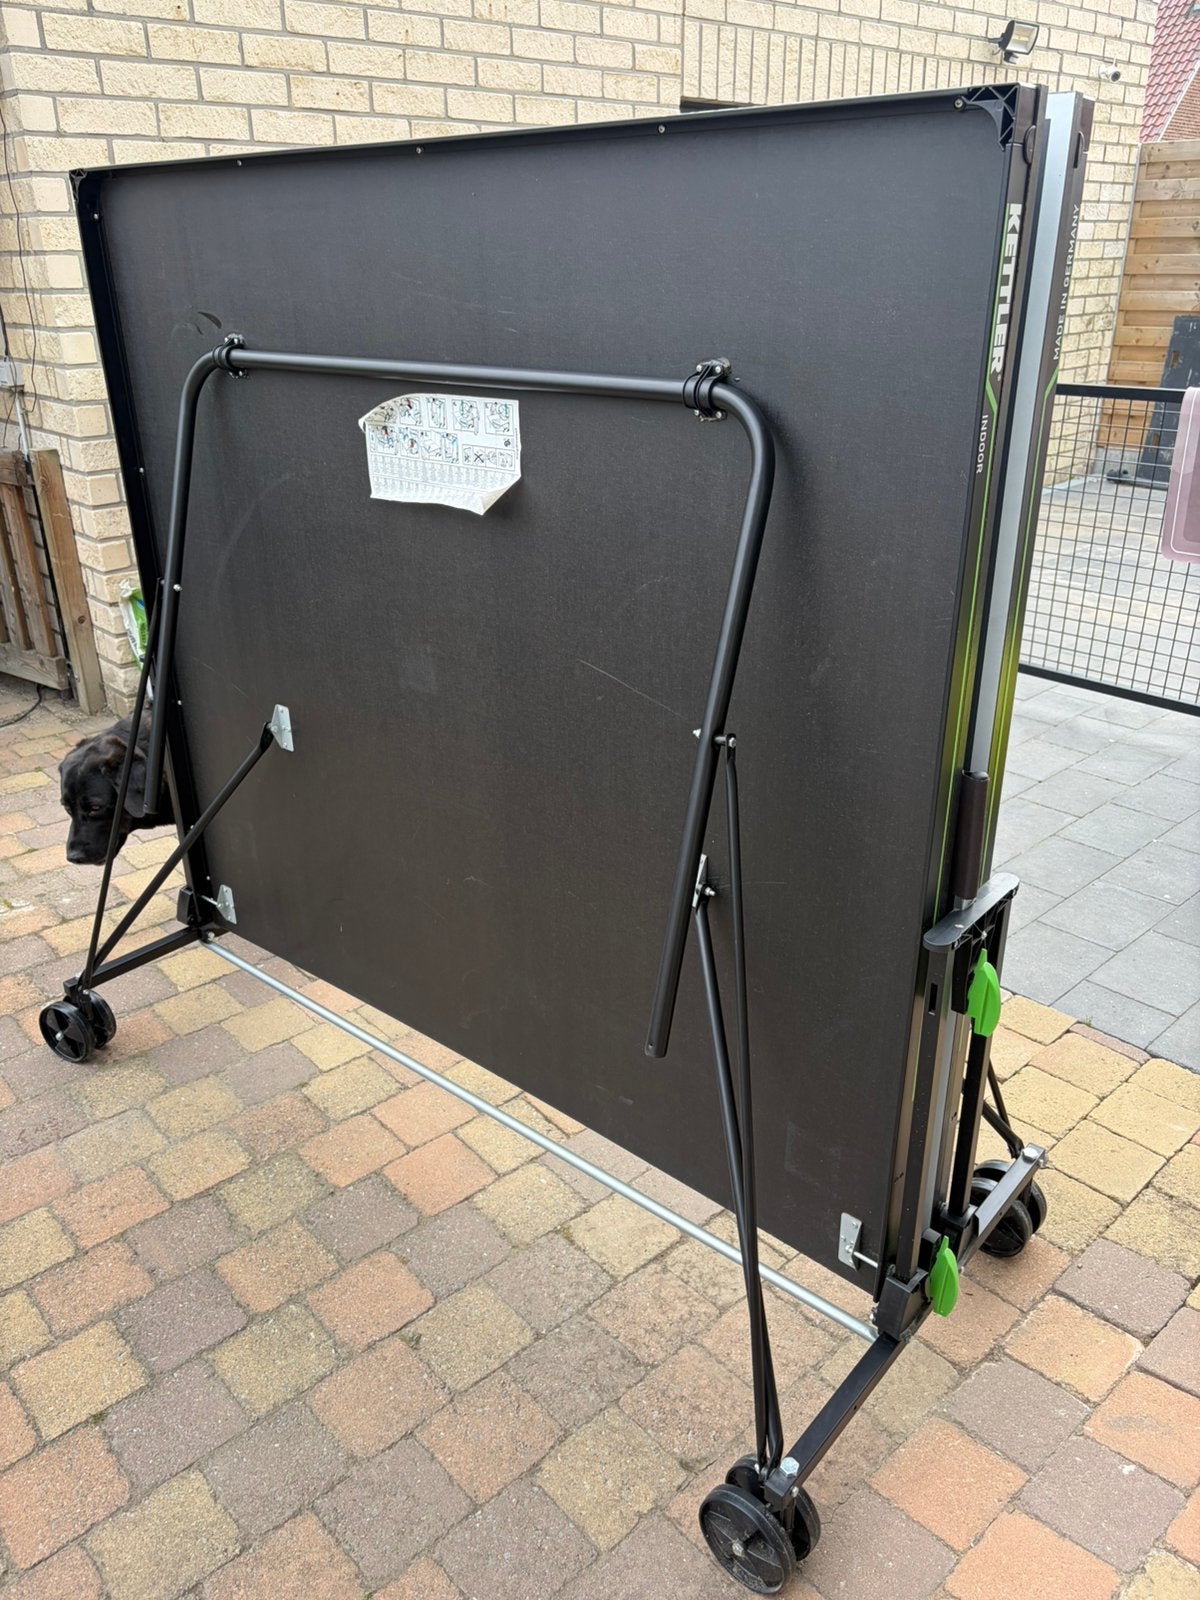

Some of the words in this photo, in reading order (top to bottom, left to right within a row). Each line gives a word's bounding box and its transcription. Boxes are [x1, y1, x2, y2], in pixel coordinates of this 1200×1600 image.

[1063, 204, 1080, 287] GERMANY
[990, 203, 1022, 375] KETTLER
[1060, 293, 1068, 309] IN
[1053, 314, 1065, 360] MADE
[976, 414, 989, 473] INDOOR
